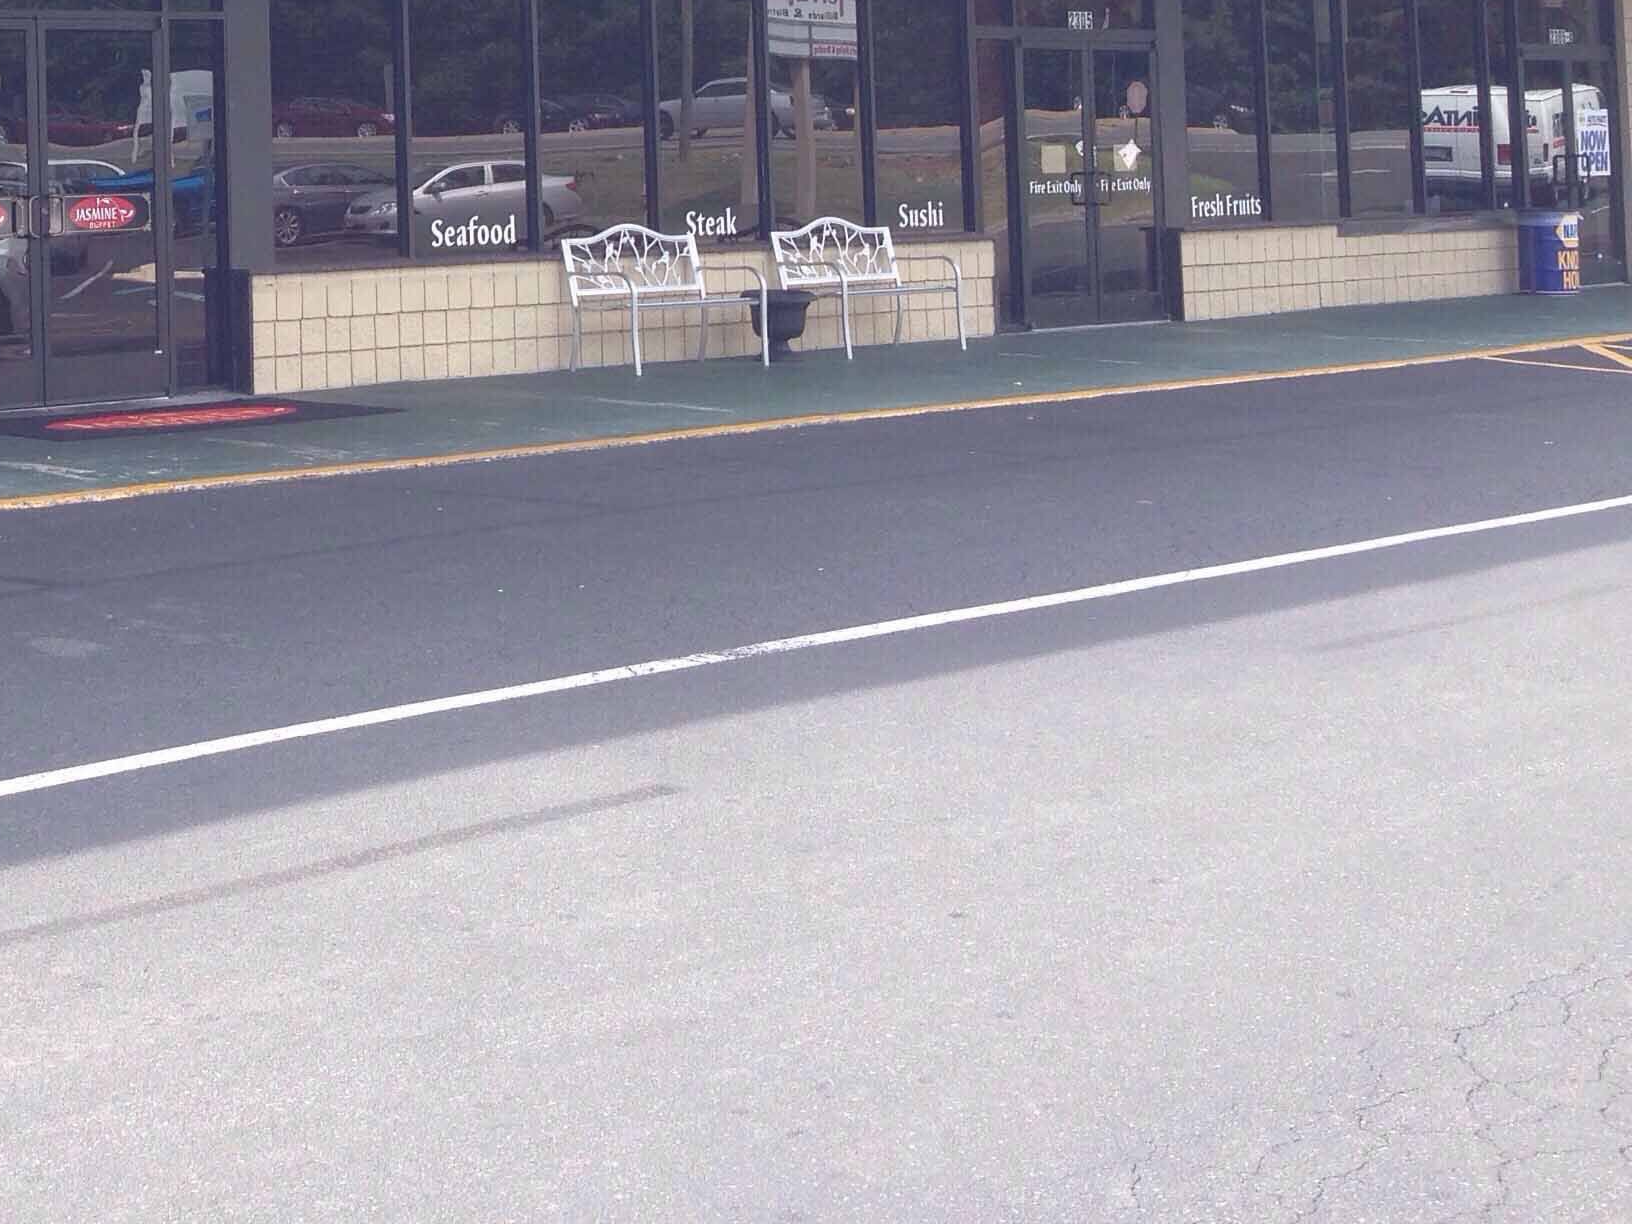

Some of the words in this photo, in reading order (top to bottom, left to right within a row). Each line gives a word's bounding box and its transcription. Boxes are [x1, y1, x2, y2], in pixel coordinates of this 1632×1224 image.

[1580, 130, 1607, 152] NOW
[1581, 151, 1608, 172] OPEN
[1029, 180, 1045, 194] Fire
[1046, 180, 1063, 194] Exit
[1063, 179, 1082, 197] Only
[1100, 178, 1116, 192] Fie
[1116, 177, 1133, 191] Exit
[1133, 176, 1152, 194] Only
[74, 207, 118, 222] JASMINE
[898, 201, 944, 229] Sushi
[1191, 193, 1225, 217] Fresh
[1225, 193, 1262, 216] Fruits
[430, 215, 517, 248] Seafood
[686, 207, 737, 236] Steak
